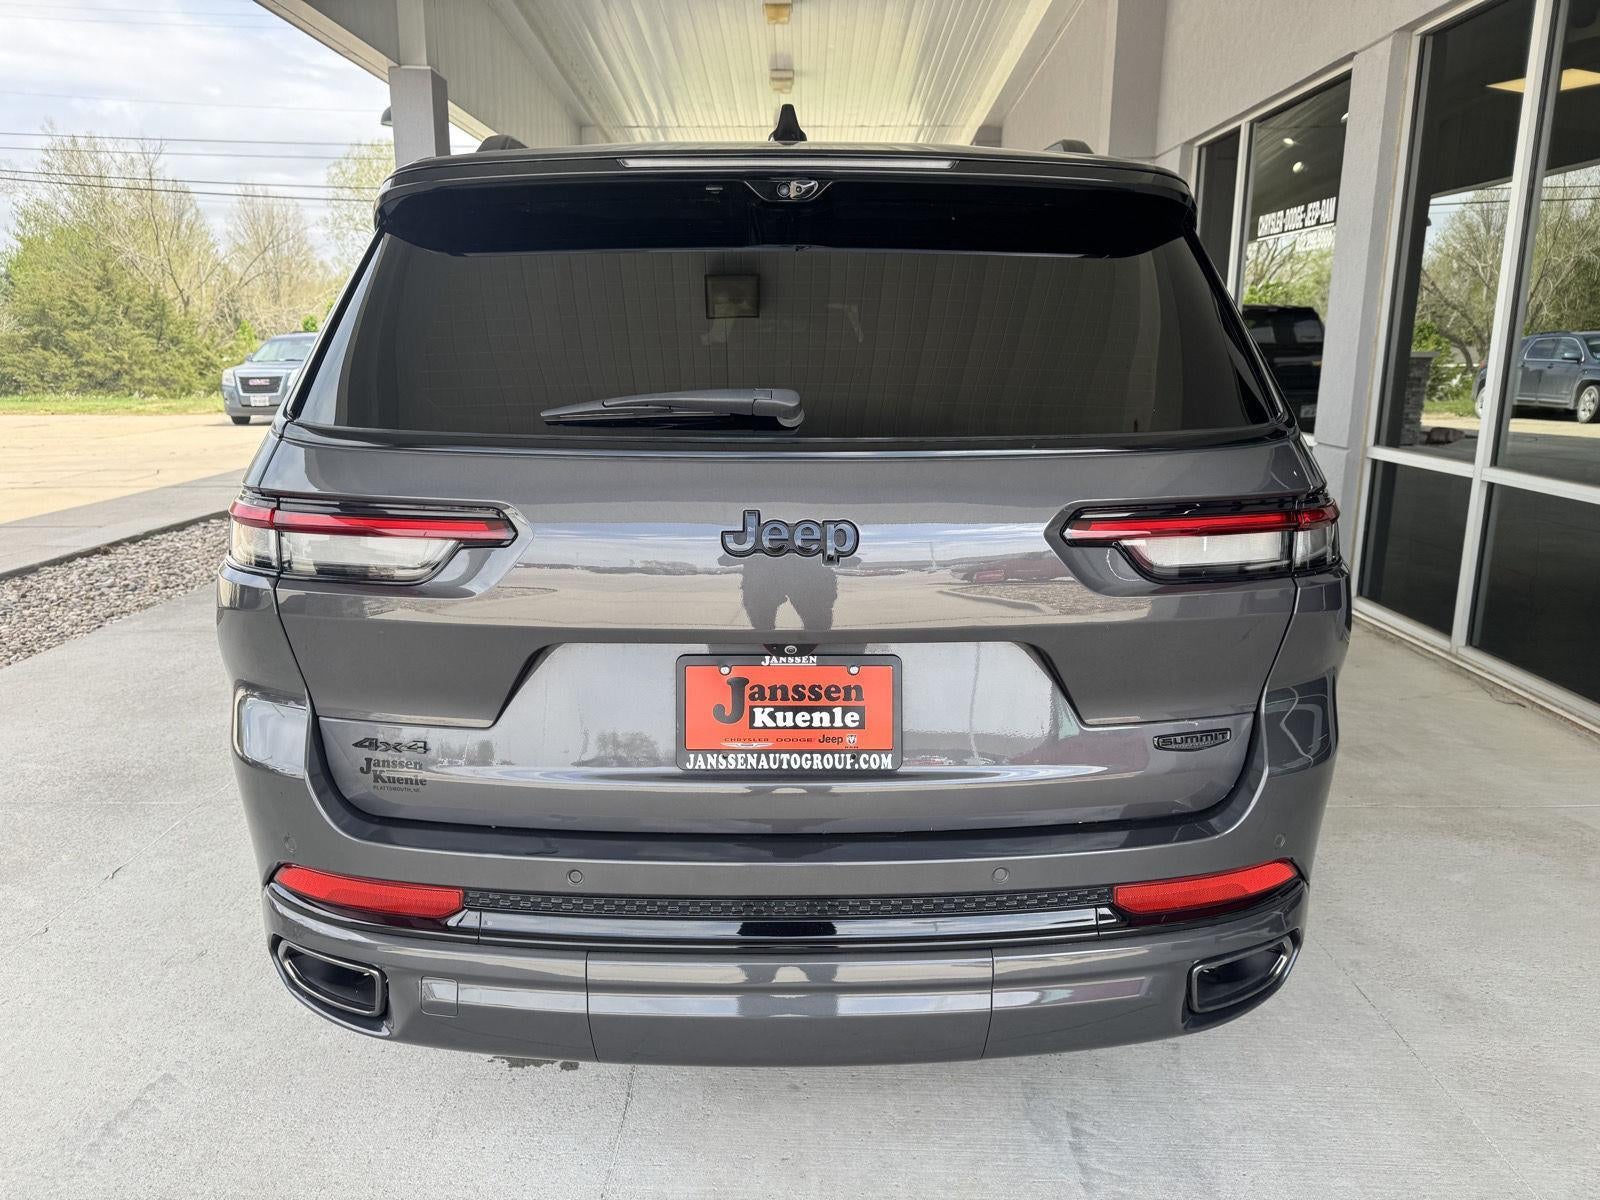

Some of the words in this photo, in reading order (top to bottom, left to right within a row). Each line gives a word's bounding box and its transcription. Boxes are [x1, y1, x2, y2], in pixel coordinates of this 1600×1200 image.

[1320, 197, 1336, 223] RAM
[721, 510, 859, 566] Jeep
[761, 656, 818, 666] JANSSEN
[713, 677, 864, 724] Janssen
[753, 708, 860, 728] Kuenle
[818, 734, 843, 745] Jeep
[1160, 732, 1228, 746] SUMMIT
[360, 758, 423, 774] Janssen
[686, 753, 893, 770] JANSSENAUTOGROUP.COM
